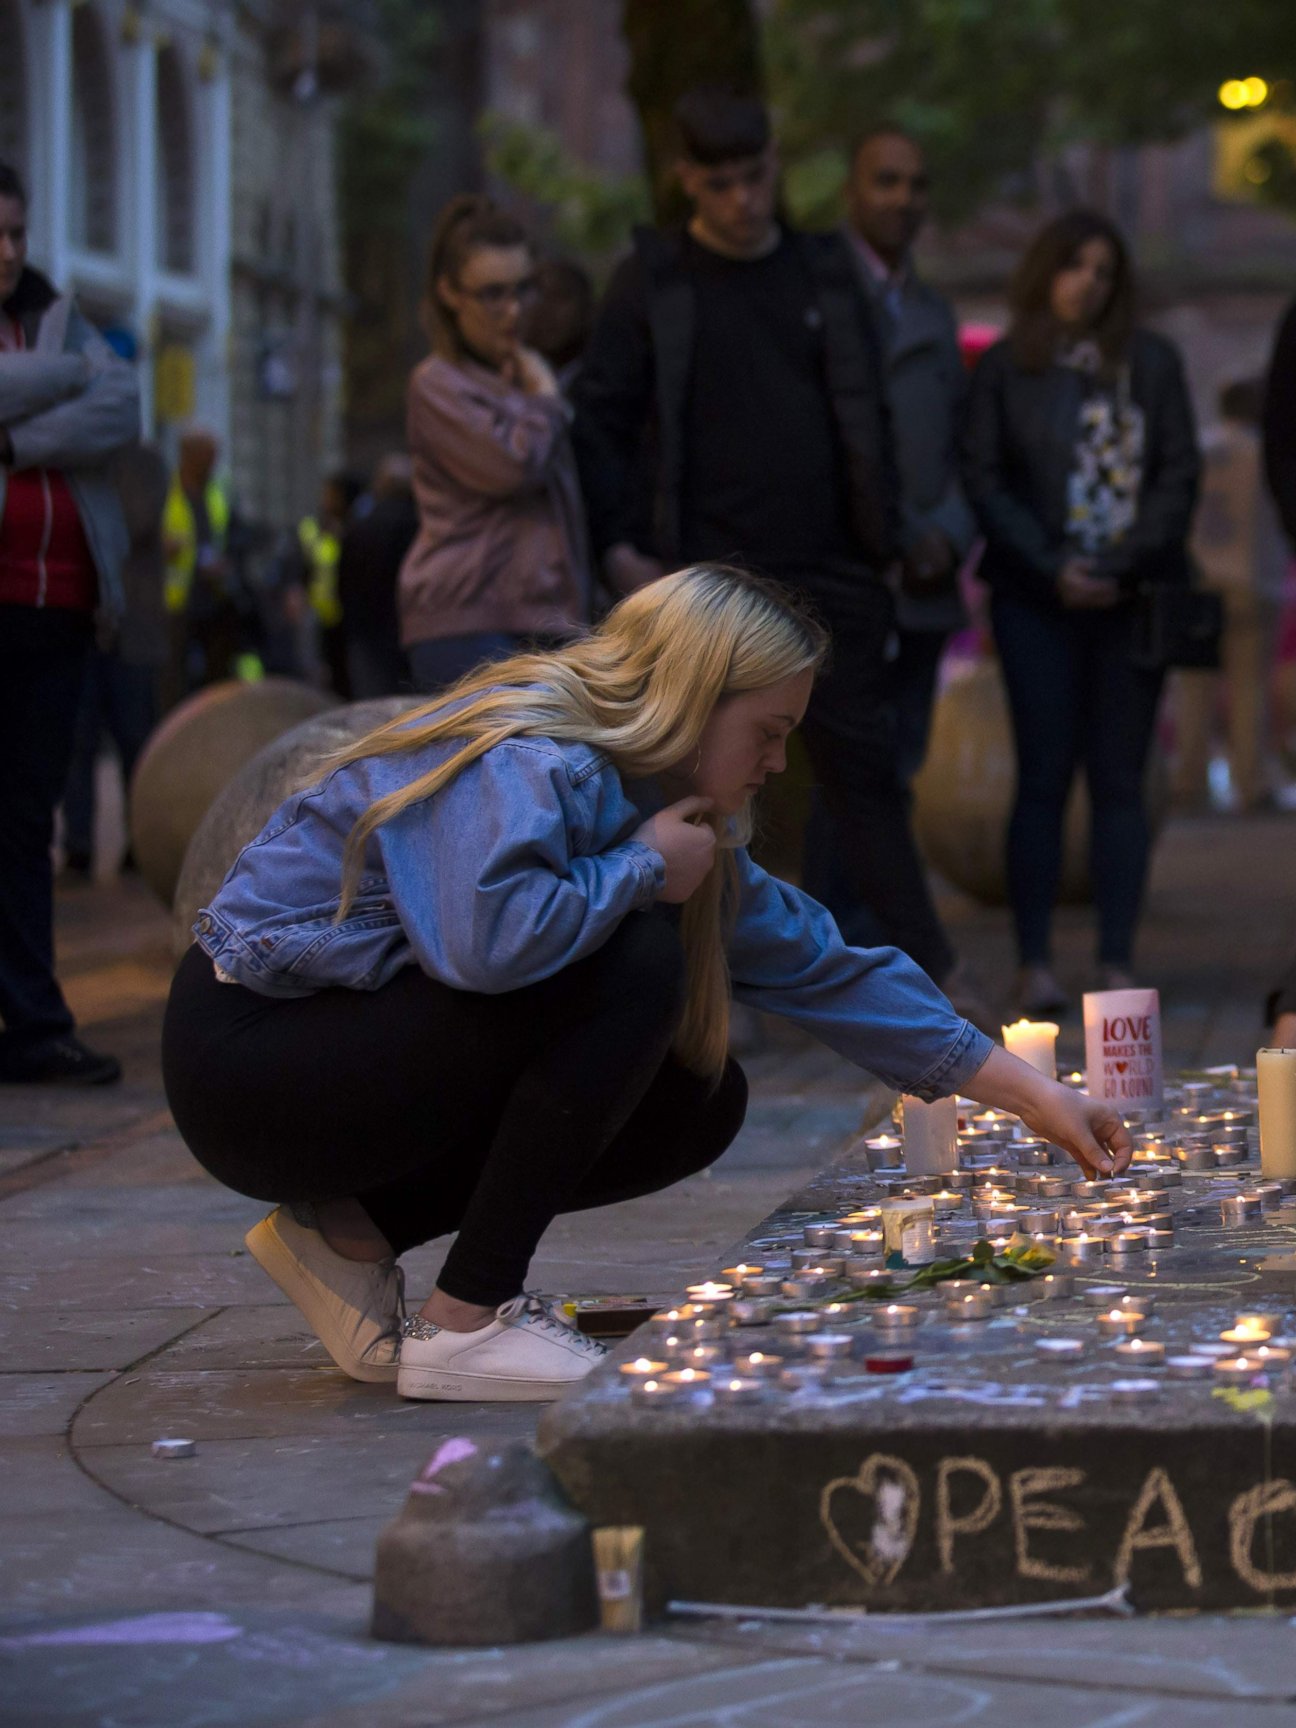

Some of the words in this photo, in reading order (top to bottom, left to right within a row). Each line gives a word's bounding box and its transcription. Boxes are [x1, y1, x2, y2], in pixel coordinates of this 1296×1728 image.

[1102, 1015, 1152, 1042] LOVE
[1102, 1044, 1136, 1058] MAKES
[1138, 1043, 1153, 1056] THE
[1105, 1078, 1117, 1099] GO
